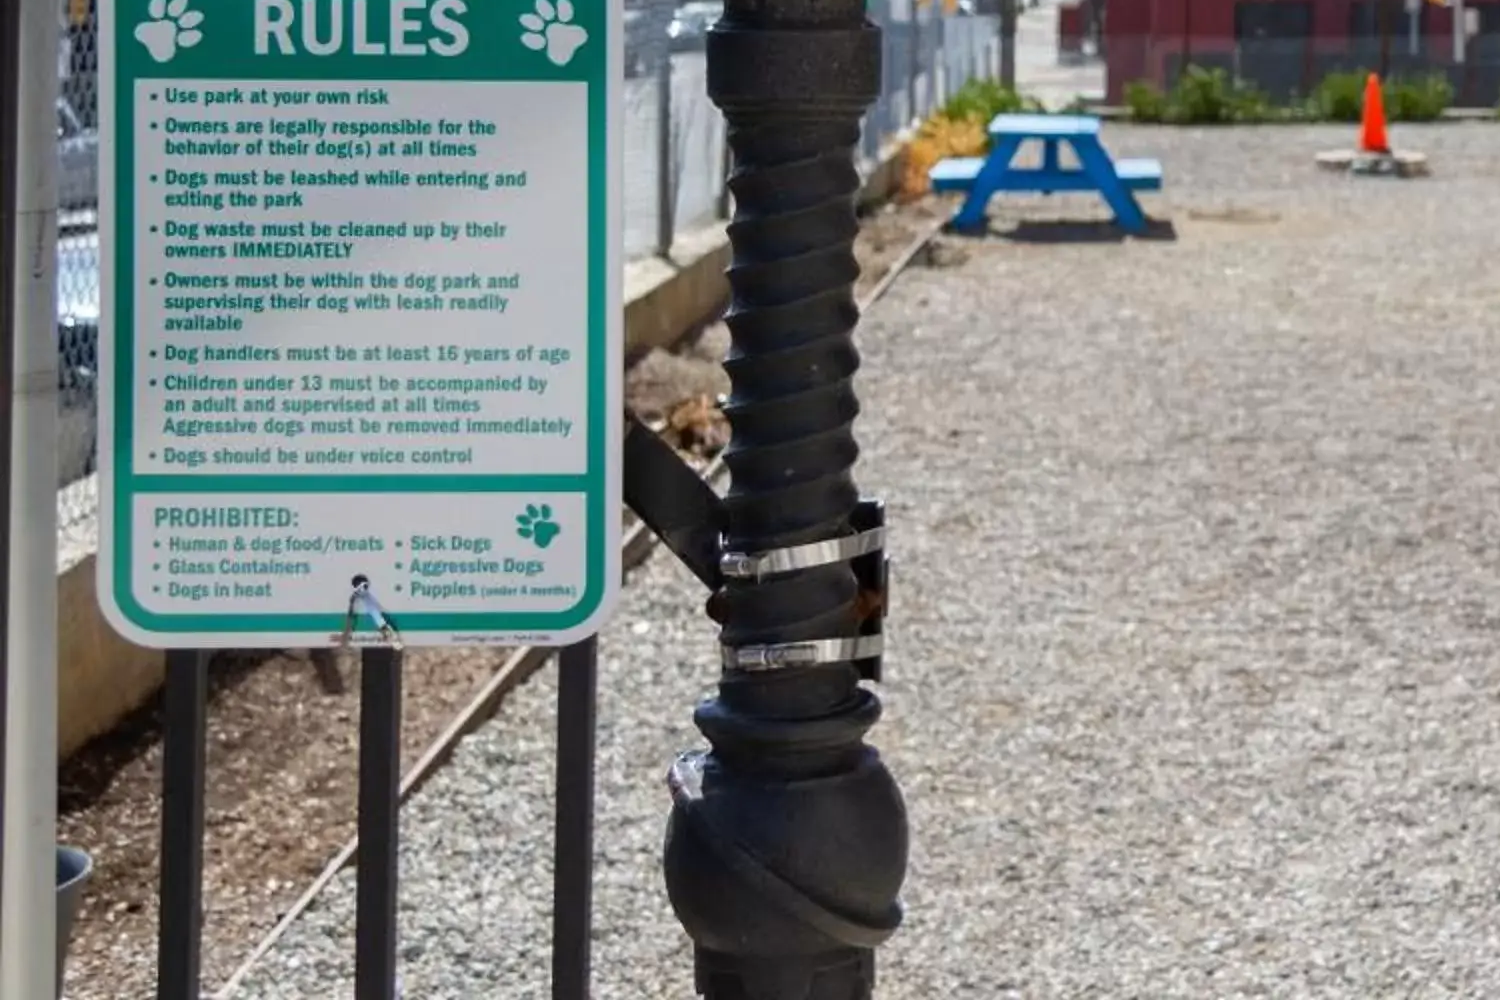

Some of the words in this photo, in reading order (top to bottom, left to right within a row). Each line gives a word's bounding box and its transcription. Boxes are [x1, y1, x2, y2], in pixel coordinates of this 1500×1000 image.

[164, 88, 199, 103] Use
[203, 88, 244, 108] park
[249, 89, 269, 104] at
[272, 92, 312, 108] your
[314, 92, 351, 104] own
[356, 88, 389, 104] risk
[164, 119, 230, 134] Owners
[234, 123, 264, 135] are
[269, 119, 327, 140] legally
[332, 119, 433, 140] responsible
[437, 120, 463, 135] for
[468, 120, 496, 136] the
[164, 140, 241, 155] behavior
[244, 140, 264, 156] of
[268, 140, 310, 156] their
[315, 140, 372, 160] dog(s)
[377, 141, 396, 156] at
[401, 140, 424, 156] all
[428, 140, 477, 156] times
[164, 170, 209, 189] Dogs
[214, 171, 258, 186] must
[263, 170, 285, 186] be
[290, 170, 359, 186] leashed
[364, 170, 411, 186] while
[415, 170, 489, 190] entering
[495, 171, 526, 186] and
[164, 191, 225, 211] exiting
[228, 191, 259, 208] the
[263, 191, 304, 212] park
[164, 222, 200, 241] Dog
[203, 223, 256, 237] waste
[258, 223, 305, 238] must
[310, 222, 335, 238] be
[337, 222, 407, 238] cleaned
[413, 226, 435, 242] up
[440, 222, 458, 242] by
[466, 222, 504, 238] their
[164, 246, 228, 258] owners
[232, 242, 354, 258] IMMEDIATELY
[163, 273, 230, 288] Owners
[234, 274, 279, 288] must
[283, 273, 306, 289] be
[310, 273, 364, 289] within
[370, 273, 398, 289] the
[404, 273, 436, 293] dog
[443, 273, 480, 293] park
[489, 273, 519, 289] and
[163, 294, 265, 313] supervising
[269, 294, 312, 310] their
[316, 294, 348, 314] dog
[354, 294, 390, 310] with
[397, 294, 443, 310] leash
[450, 294, 507, 314] readily
[163, 315, 244, 331] available
[163, 346, 199, 365] Dog
[203, 346, 280, 361] handlers
[286, 347, 329, 361] must
[335, 346, 357, 361] be
[364, 347, 381, 361] at
[387, 346, 430, 361] least
[438, 346, 458, 361] 16
[464, 350, 510, 365] years
[516, 346, 532, 361] of
[539, 350, 569, 365] age
[162, 375, 238, 391] Children
[243, 375, 294, 391] under
[301, 375, 323, 391] 13
[329, 376, 372, 391] must
[378, 375, 400, 391] be
[406, 375, 522, 394] accompanied
[528, 375, 547, 394] by
[162, 401, 187, 412] an
[191, 397, 238, 412] adult
[242, 397, 276, 412] and
[281, 397, 376, 416] supervised
[381, 398, 399, 412] at
[404, 397, 427, 412] all
[432, 397, 481, 412] times
[162, 418, 258, 437] Aggressive
[263, 418, 304, 437] dogs
[311, 419, 354, 433] must
[360, 418, 381, 433] be
[387, 418, 460, 433] removed
[466, 418, 572, 437] immediately
[163, 448, 208, 467] Dogs
[212, 448, 272, 463] should
[276, 448, 299, 463] be
[304, 448, 355, 463] under
[360, 448, 405, 463] voice
[410, 448, 472, 463] control
[154, 508, 300, 528] PROHIBITED:
[169, 536, 229, 551] Human
[232, 536, 247, 551] &
[249, 536, 282, 555] dog
[284, 536, 385, 551] food/treats
[410, 536, 447, 551] Sick
[450, 536, 492, 555] Dogs
[168, 559, 216, 574] Glass
[218, 559, 311, 574] Containers
[410, 559, 500, 577] Aggressive
[502, 559, 545, 577] Dogs
[168, 582, 211, 600] Dogs
[213, 582, 230, 597] in
[233, 582, 272, 597] heat
[410, 581, 477, 599] Puppies
